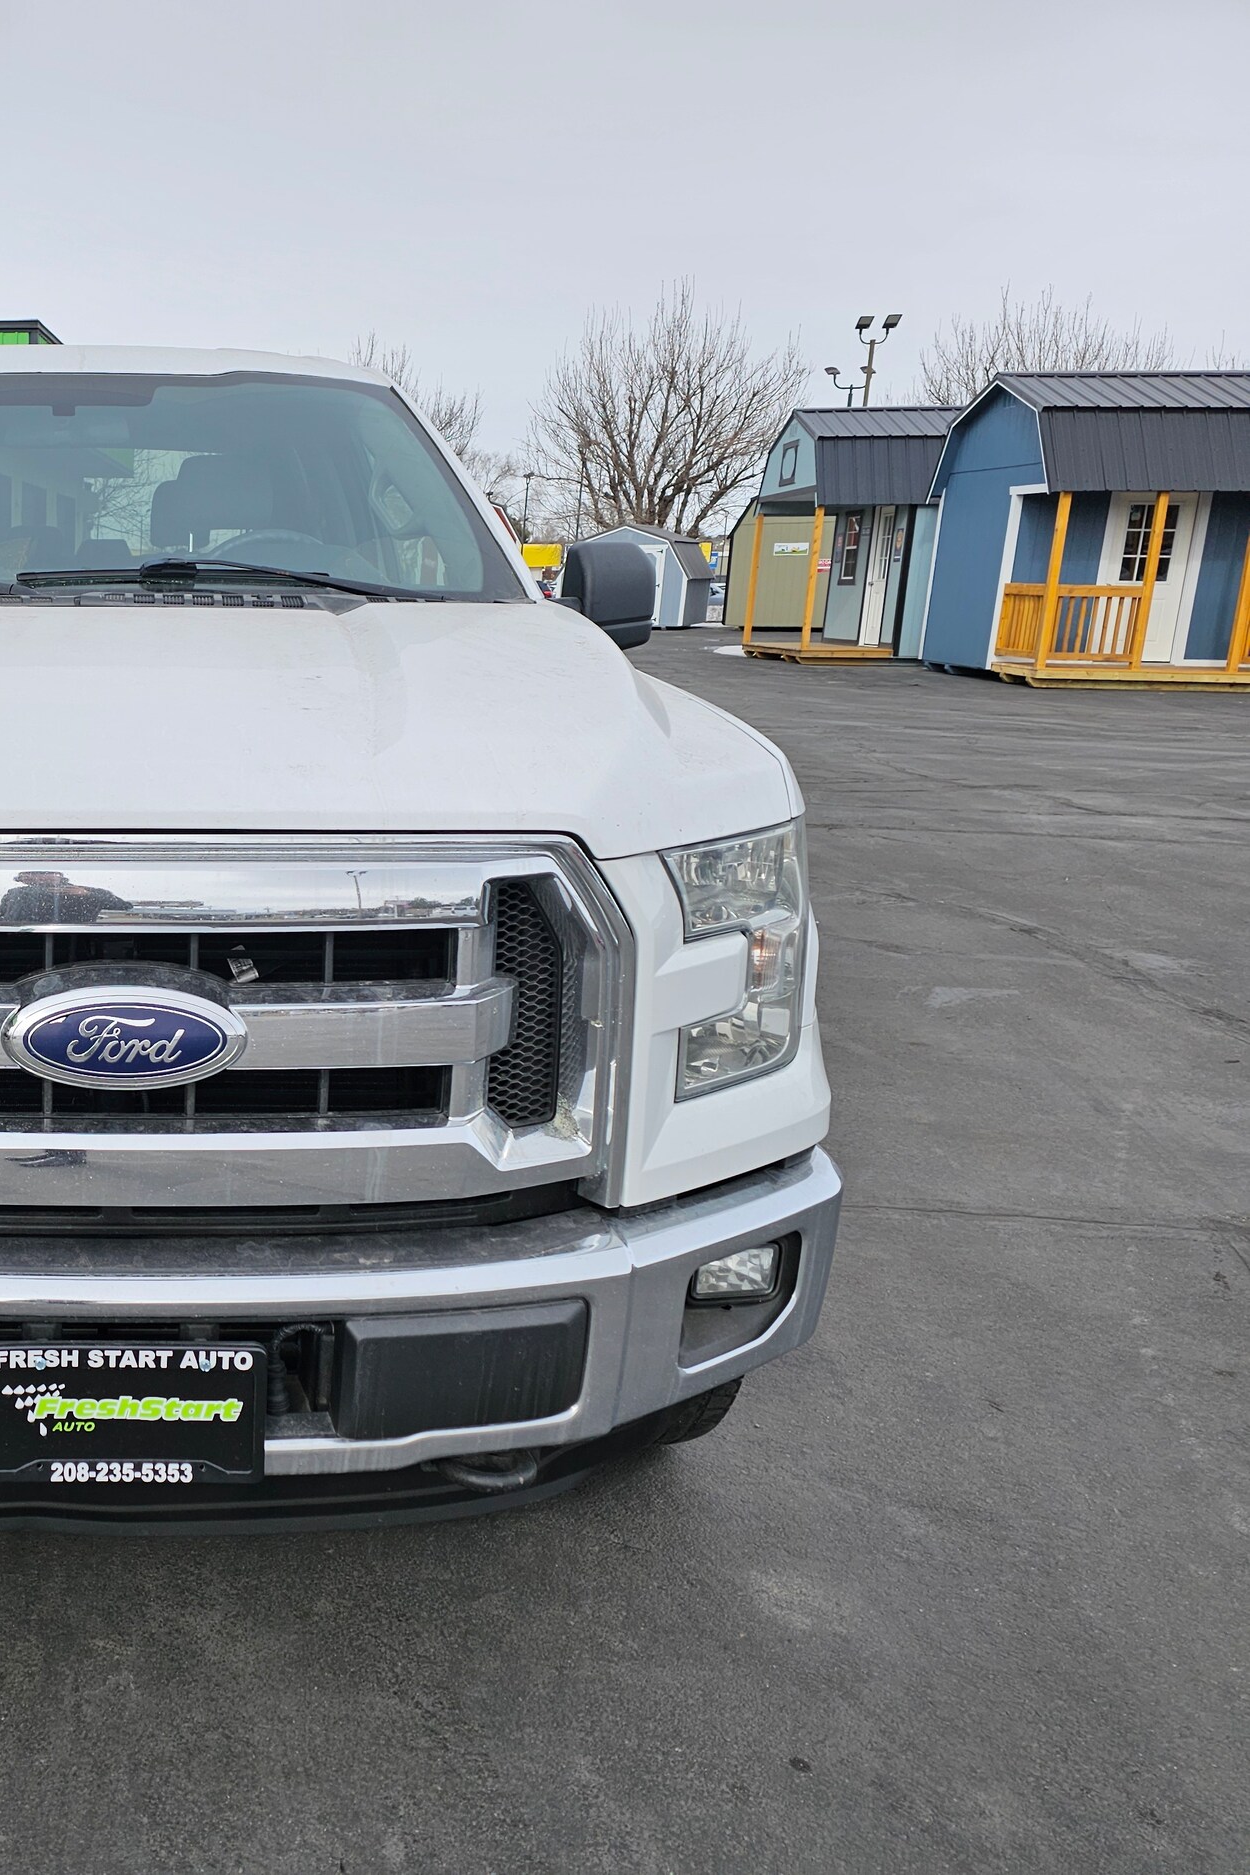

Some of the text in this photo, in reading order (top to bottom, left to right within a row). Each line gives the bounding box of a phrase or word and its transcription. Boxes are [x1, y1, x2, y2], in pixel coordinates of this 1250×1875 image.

[66, 1015, 185, 1063] Ford
[87, 1350, 173, 1369] START
[180, 1350, 254, 1371] AUTO
[34, 1395, 244, 1422] FreshStart
[52, 1421, 95, 1432] AUTO
[50, 1462, 193, 1483] 208-235-5353
